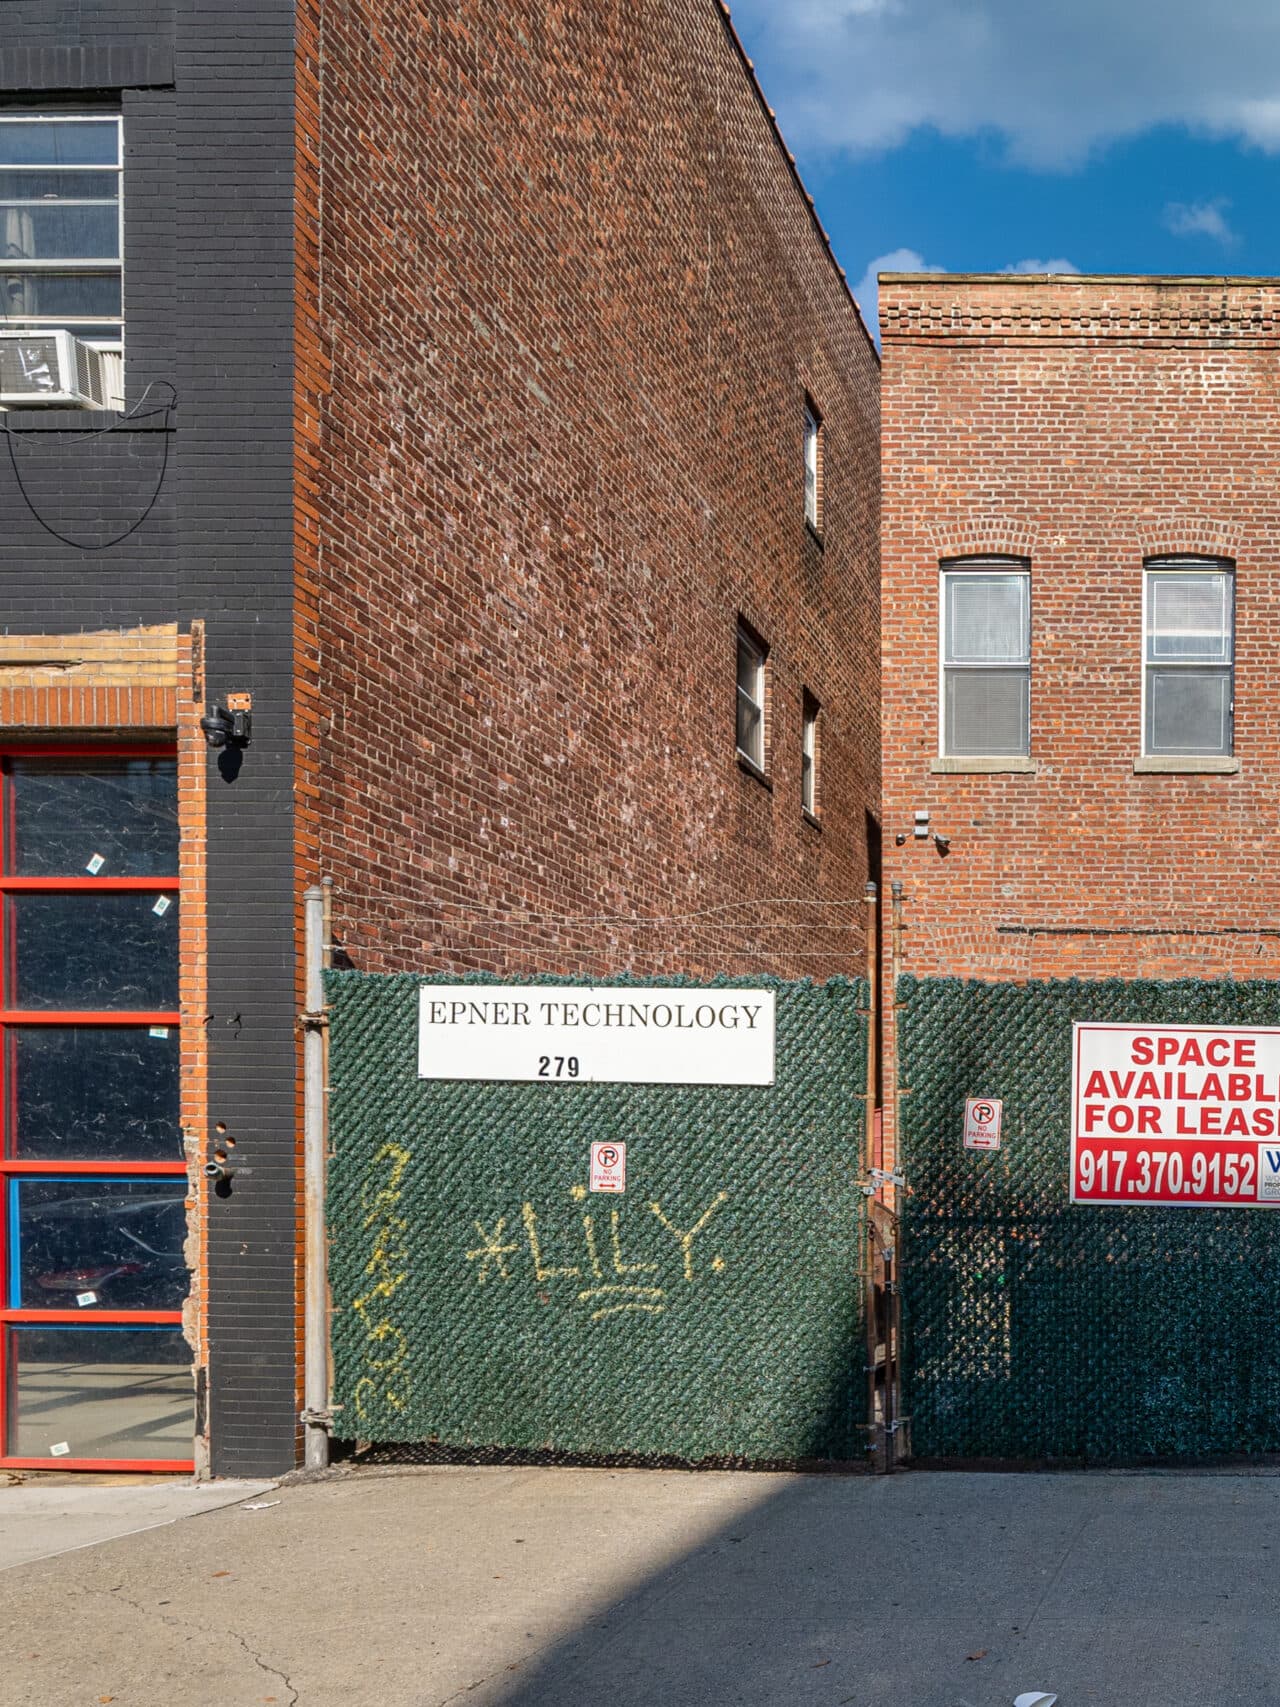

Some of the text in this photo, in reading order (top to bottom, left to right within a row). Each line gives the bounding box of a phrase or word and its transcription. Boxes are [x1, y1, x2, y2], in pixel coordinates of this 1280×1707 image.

[428, 1001, 763, 1029] EPNER TECHNOLOGY
[1131, 1036, 1256, 1068] SPACE
[538, 1055, 580, 1078] 279
[1084, 1104, 1163, 1134] FOR
[968, 1131, 996, 1139] PARKING
[594, 1174, 622, 1182] PARKING
[1079, 1149, 1256, 1196] 917.370.9152
